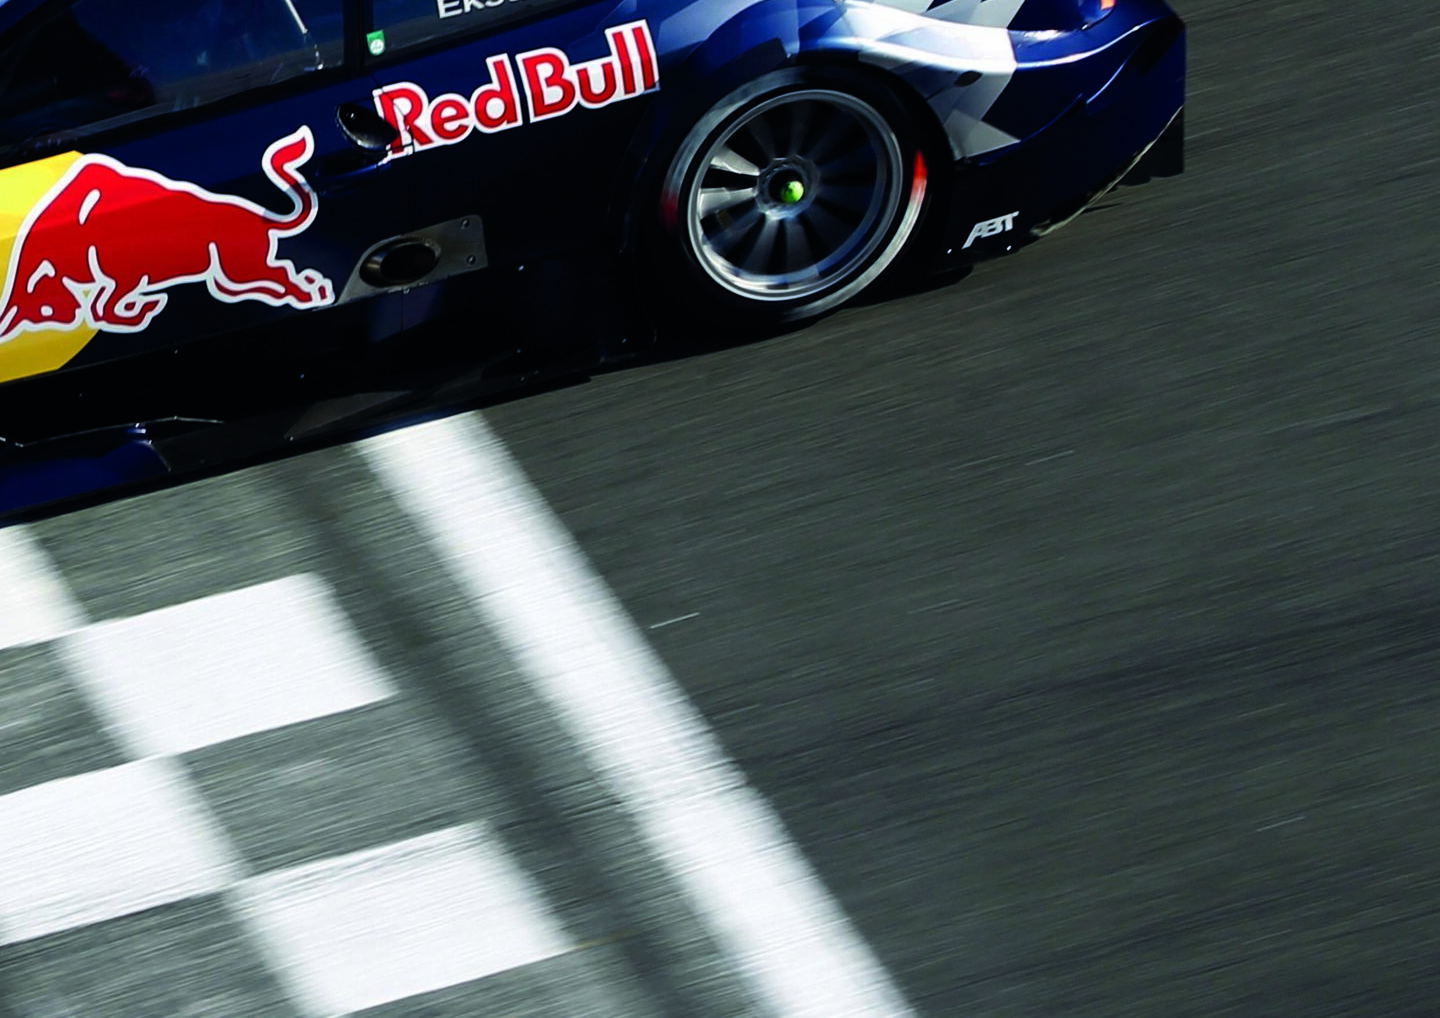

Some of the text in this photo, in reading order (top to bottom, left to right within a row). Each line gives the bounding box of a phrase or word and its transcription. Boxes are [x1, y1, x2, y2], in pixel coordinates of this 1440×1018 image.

[373, 19, 660, 159] Red Bull
[961, 210, 1020, 250] ABT
